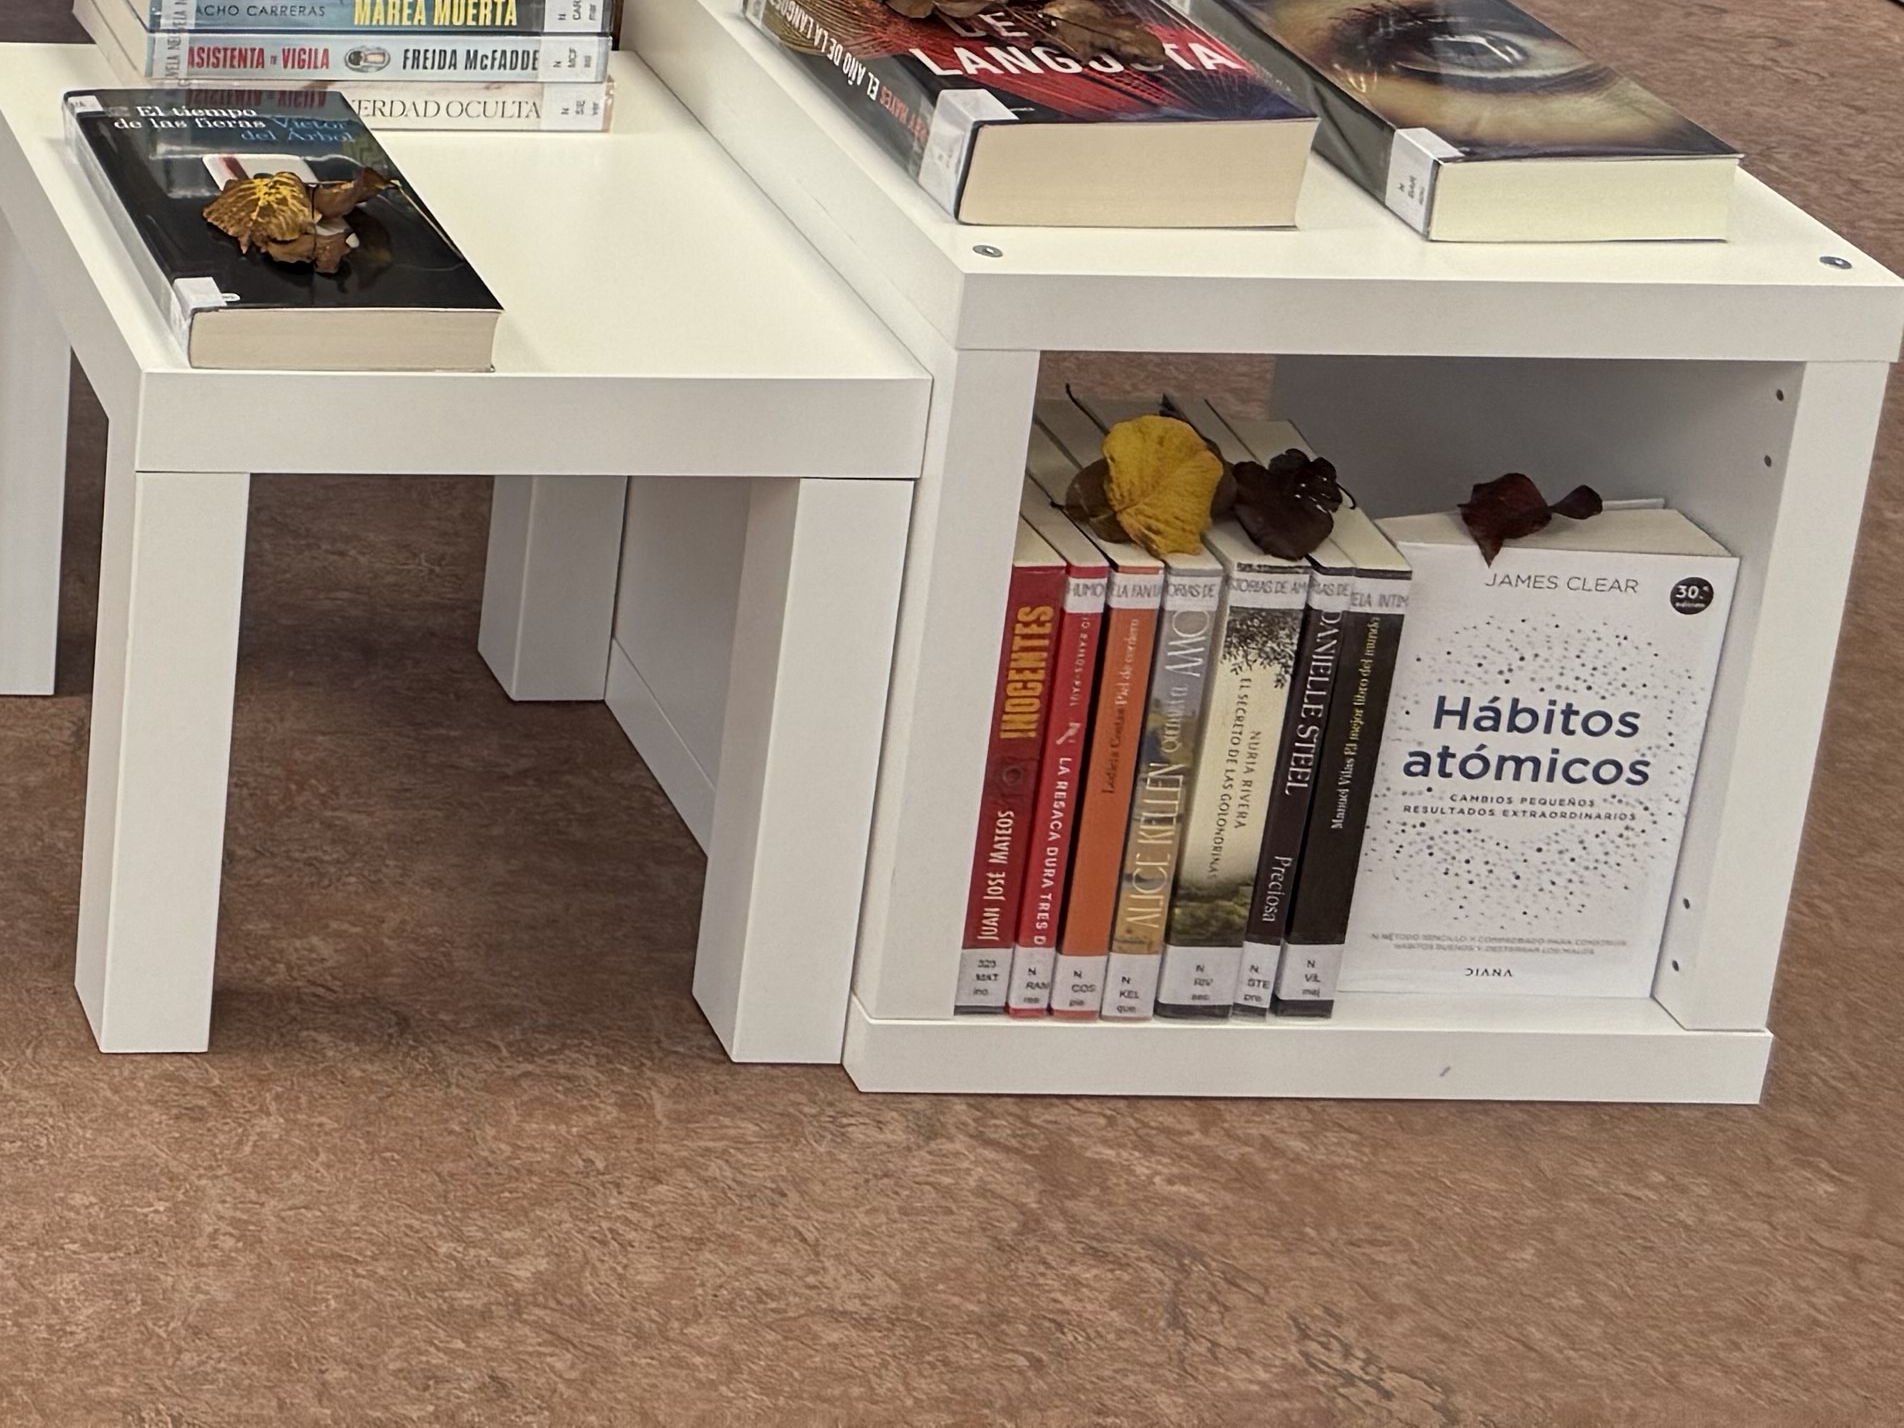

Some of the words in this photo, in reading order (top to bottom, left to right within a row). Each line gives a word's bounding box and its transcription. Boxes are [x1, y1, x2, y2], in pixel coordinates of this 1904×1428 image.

[195, 3, 239, 18] ACHO
[246, 4, 326, 19] CARRERAS
[572, 0, 581, 21] CAR
[113, 117, 144, 129] de
[149, 116, 188, 129] las
[194, 115, 266, 130] fieras
[272, 115, 349, 130] Víctor
[136, 105, 166, 117] El
[171, 105, 258, 120] tiempo
[239, 127, 280, 142] del
[285, 126, 355, 143] Árbol
[1485, 573, 1559, 591] JAMES
[1566, 575, 1639, 594] CLEAR
[999, 605, 1054, 739] INOCENTES
[1300, 611, 1343, 719] DANIELLE
[1431, 694, 1641, 739] Hábitos
[1242, 729, 1262, 776] NURIA
[1285, 723, 1320, 795] STEEL
[1402, 743, 1651, 787] atómicos
[1136, 763, 1186, 844] KELLEN
[1233, 777, 1253, 830] RIVERA
[1449, 793, 1513, 806] CAMBIOS
[1519, 796, 1595, 809] PEQUEÑOS
[1402, 804, 1496, 818] RESULTADOS
[1501, 808, 1637, 822] EXTRAORDINARIOS
[997, 809, 1014, 867] MATEOS
[987, 869, 1007, 902] JOSÉ
[1125, 853, 1172, 929] ALICE
[1261, 854, 1292, 924] Preciosa
[978, 907, 1002, 941] JUAN
[1250, 964, 1259, 973] N
[1307, 960, 1316, 969] N
[1464, 967, 1513, 978] DIANA
[1071, 983, 1096, 993] COS
[1248, 979, 1270, 989] STE
[1304, 974, 1321, 983] VIL
[1120, 989, 1139, 999] KEL
[1116, 1004, 1137, 1014] que
